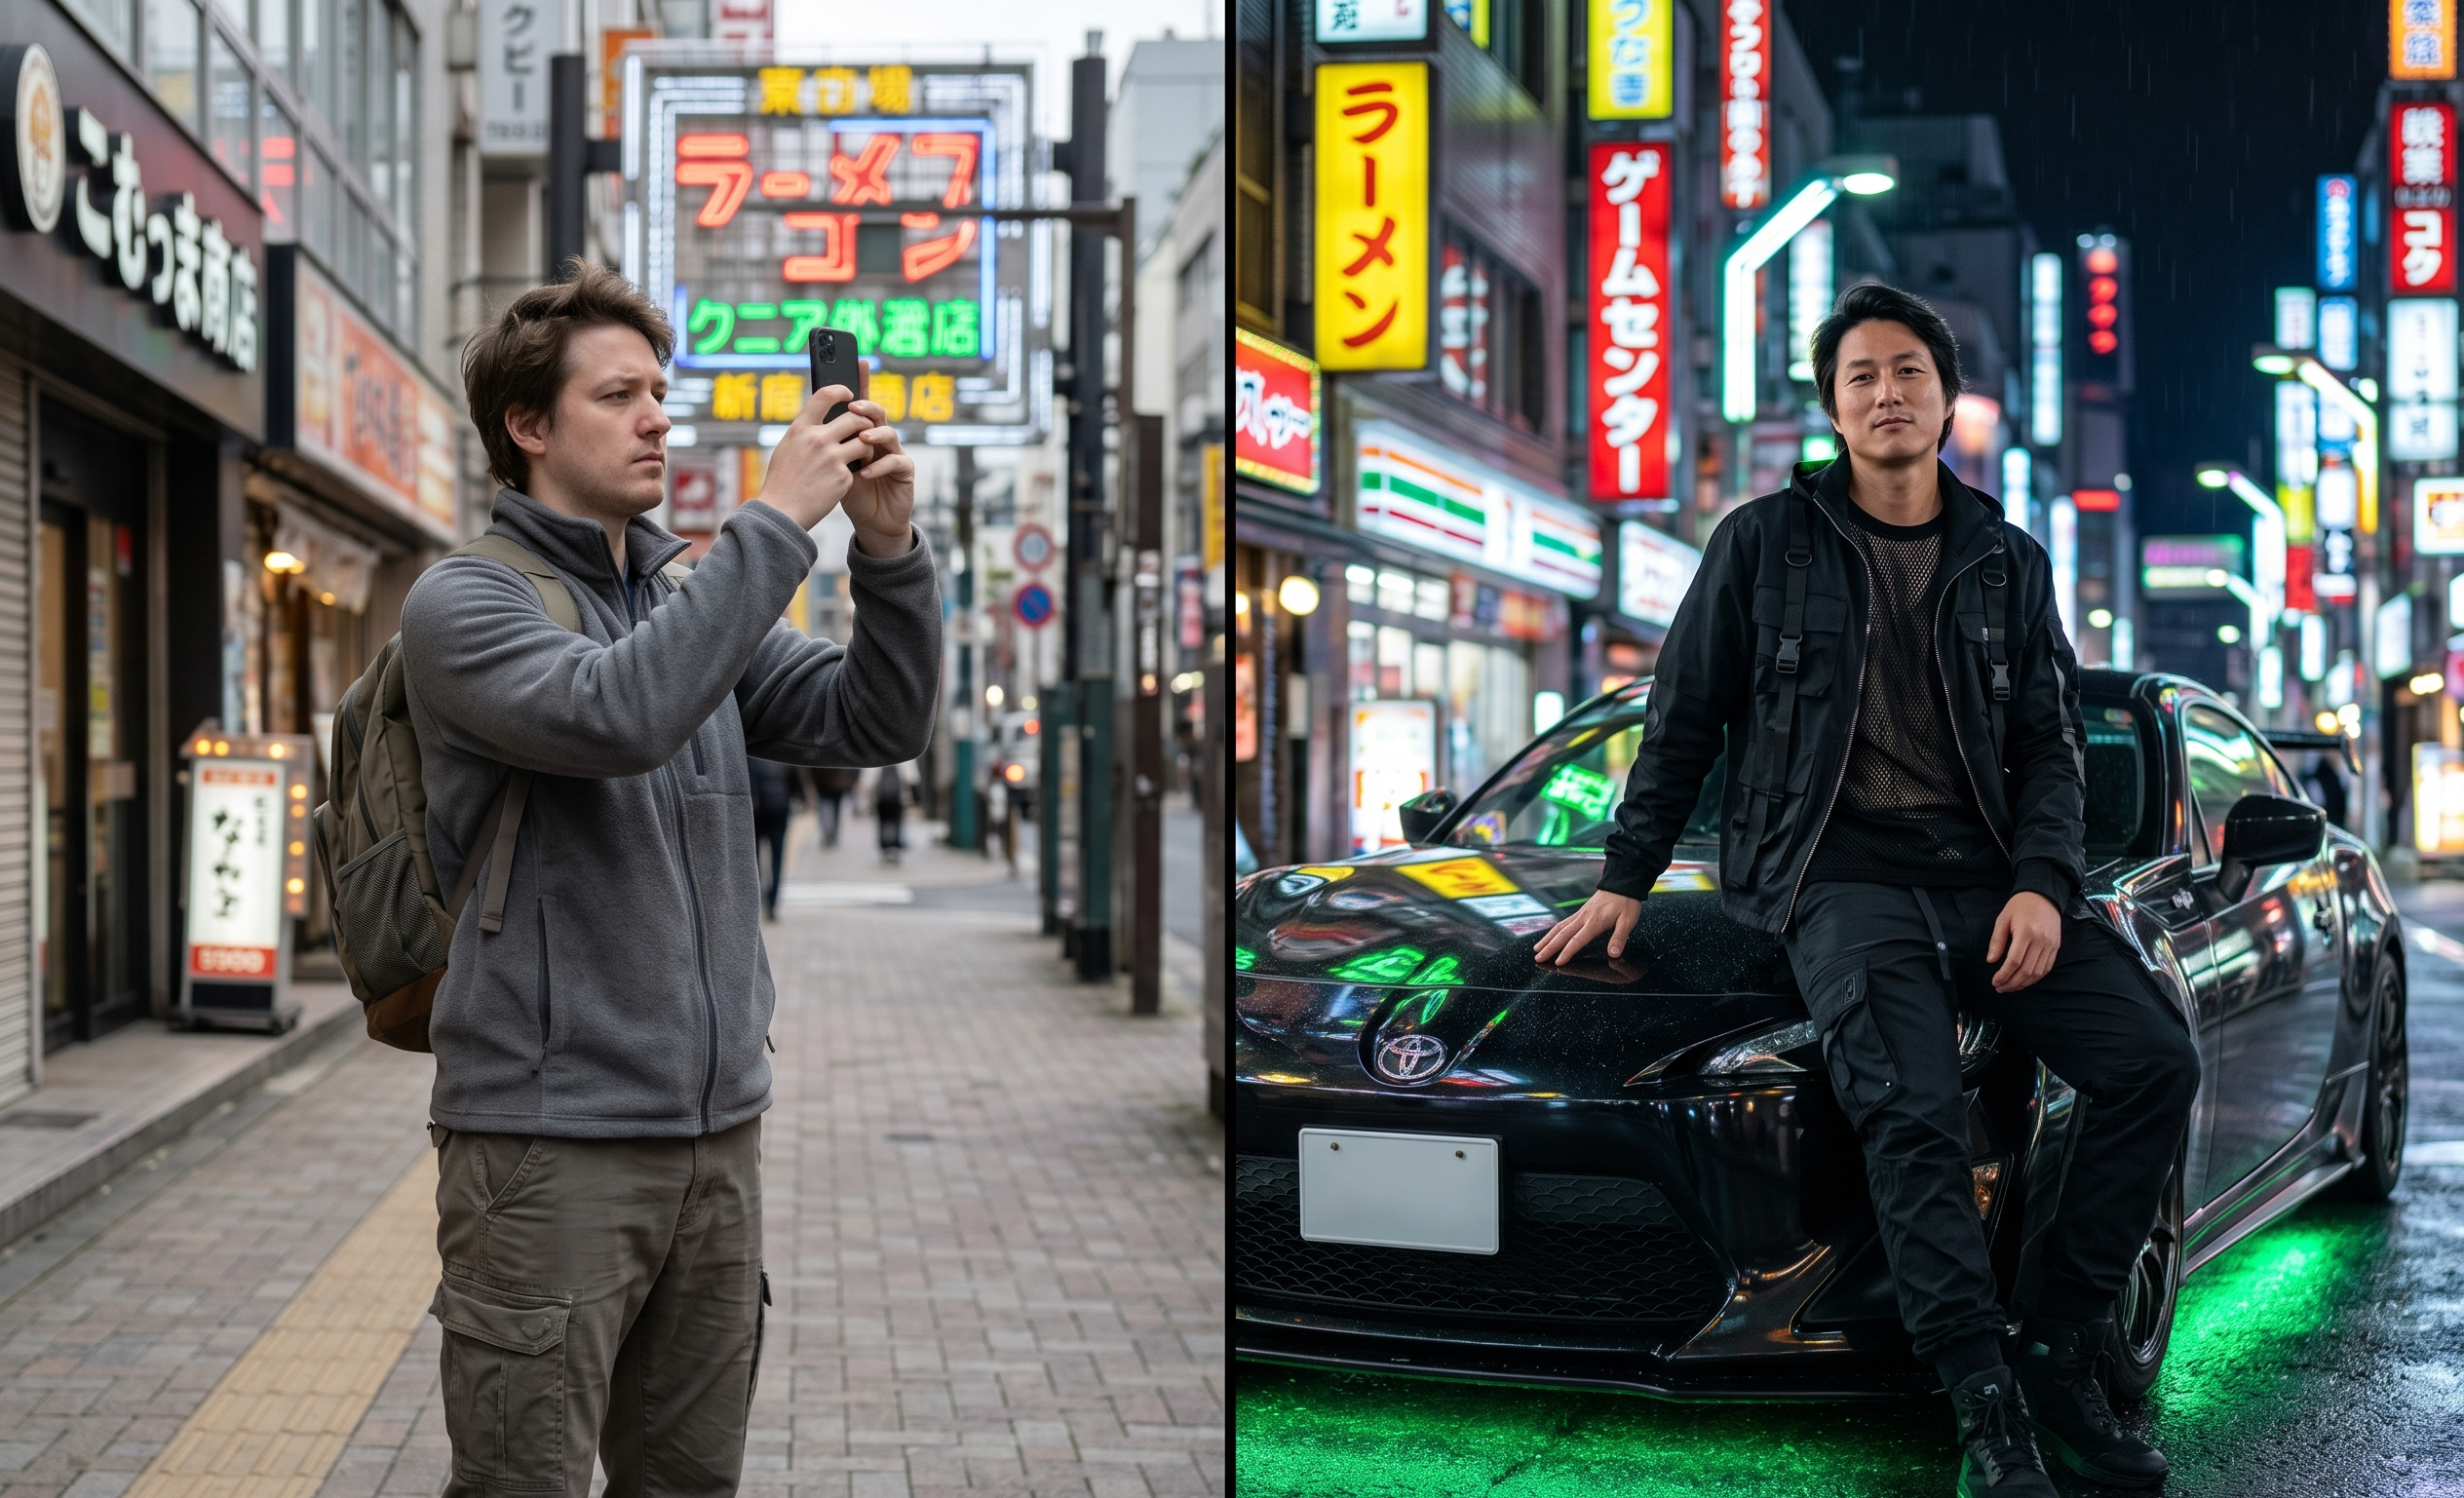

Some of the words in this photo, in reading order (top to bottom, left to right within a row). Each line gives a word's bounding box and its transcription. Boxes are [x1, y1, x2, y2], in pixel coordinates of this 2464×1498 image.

[1342, 82, 1399, 348] ラーメン
[1600, 149, 1661, 493] ゲームセンター
